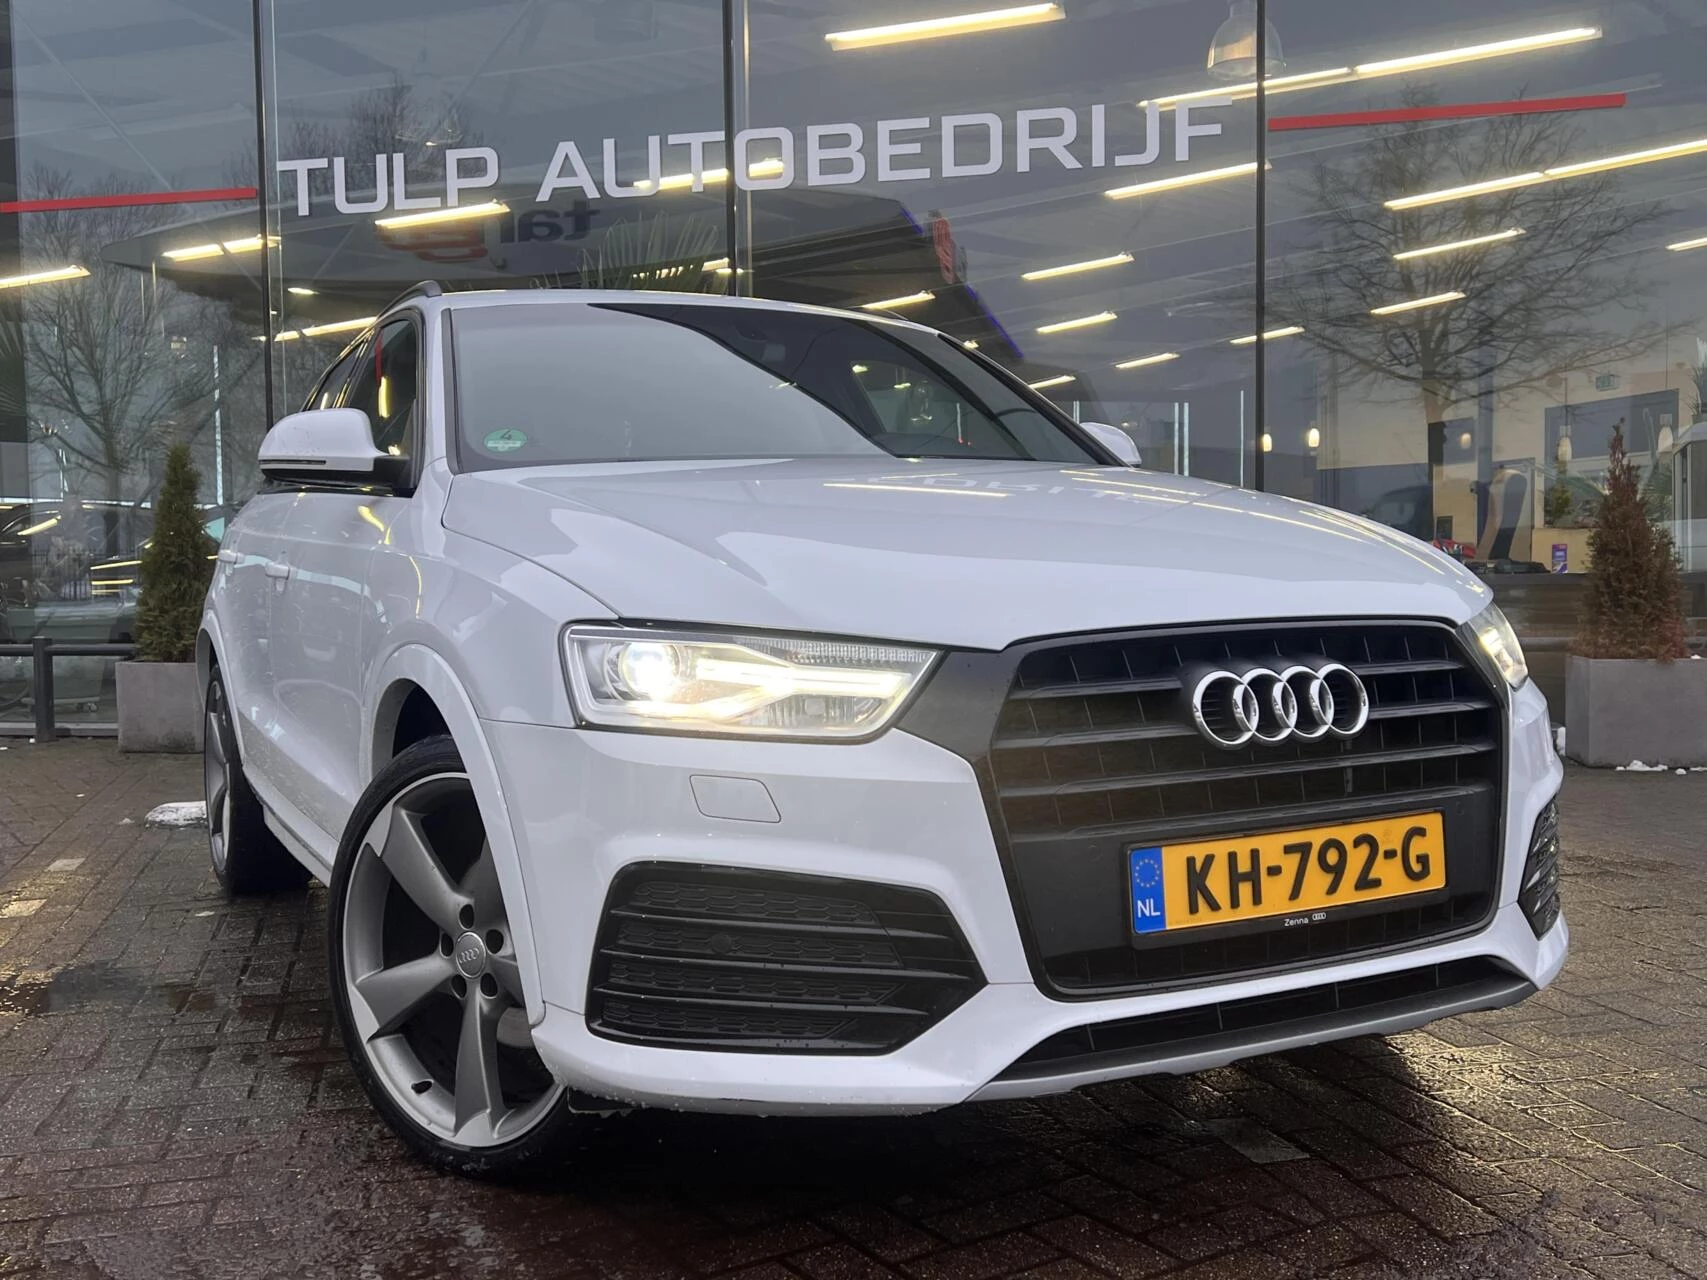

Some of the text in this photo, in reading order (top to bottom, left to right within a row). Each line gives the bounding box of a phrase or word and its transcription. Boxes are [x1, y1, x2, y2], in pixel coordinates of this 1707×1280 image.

[276, 97, 1233, 216] TULP AUTOBEDRIJF
[1186, 826, 1431, 915] KH-792-G
[1137, 898, 1160, 918] NL
[1284, 917, 1309, 927] Zenna
